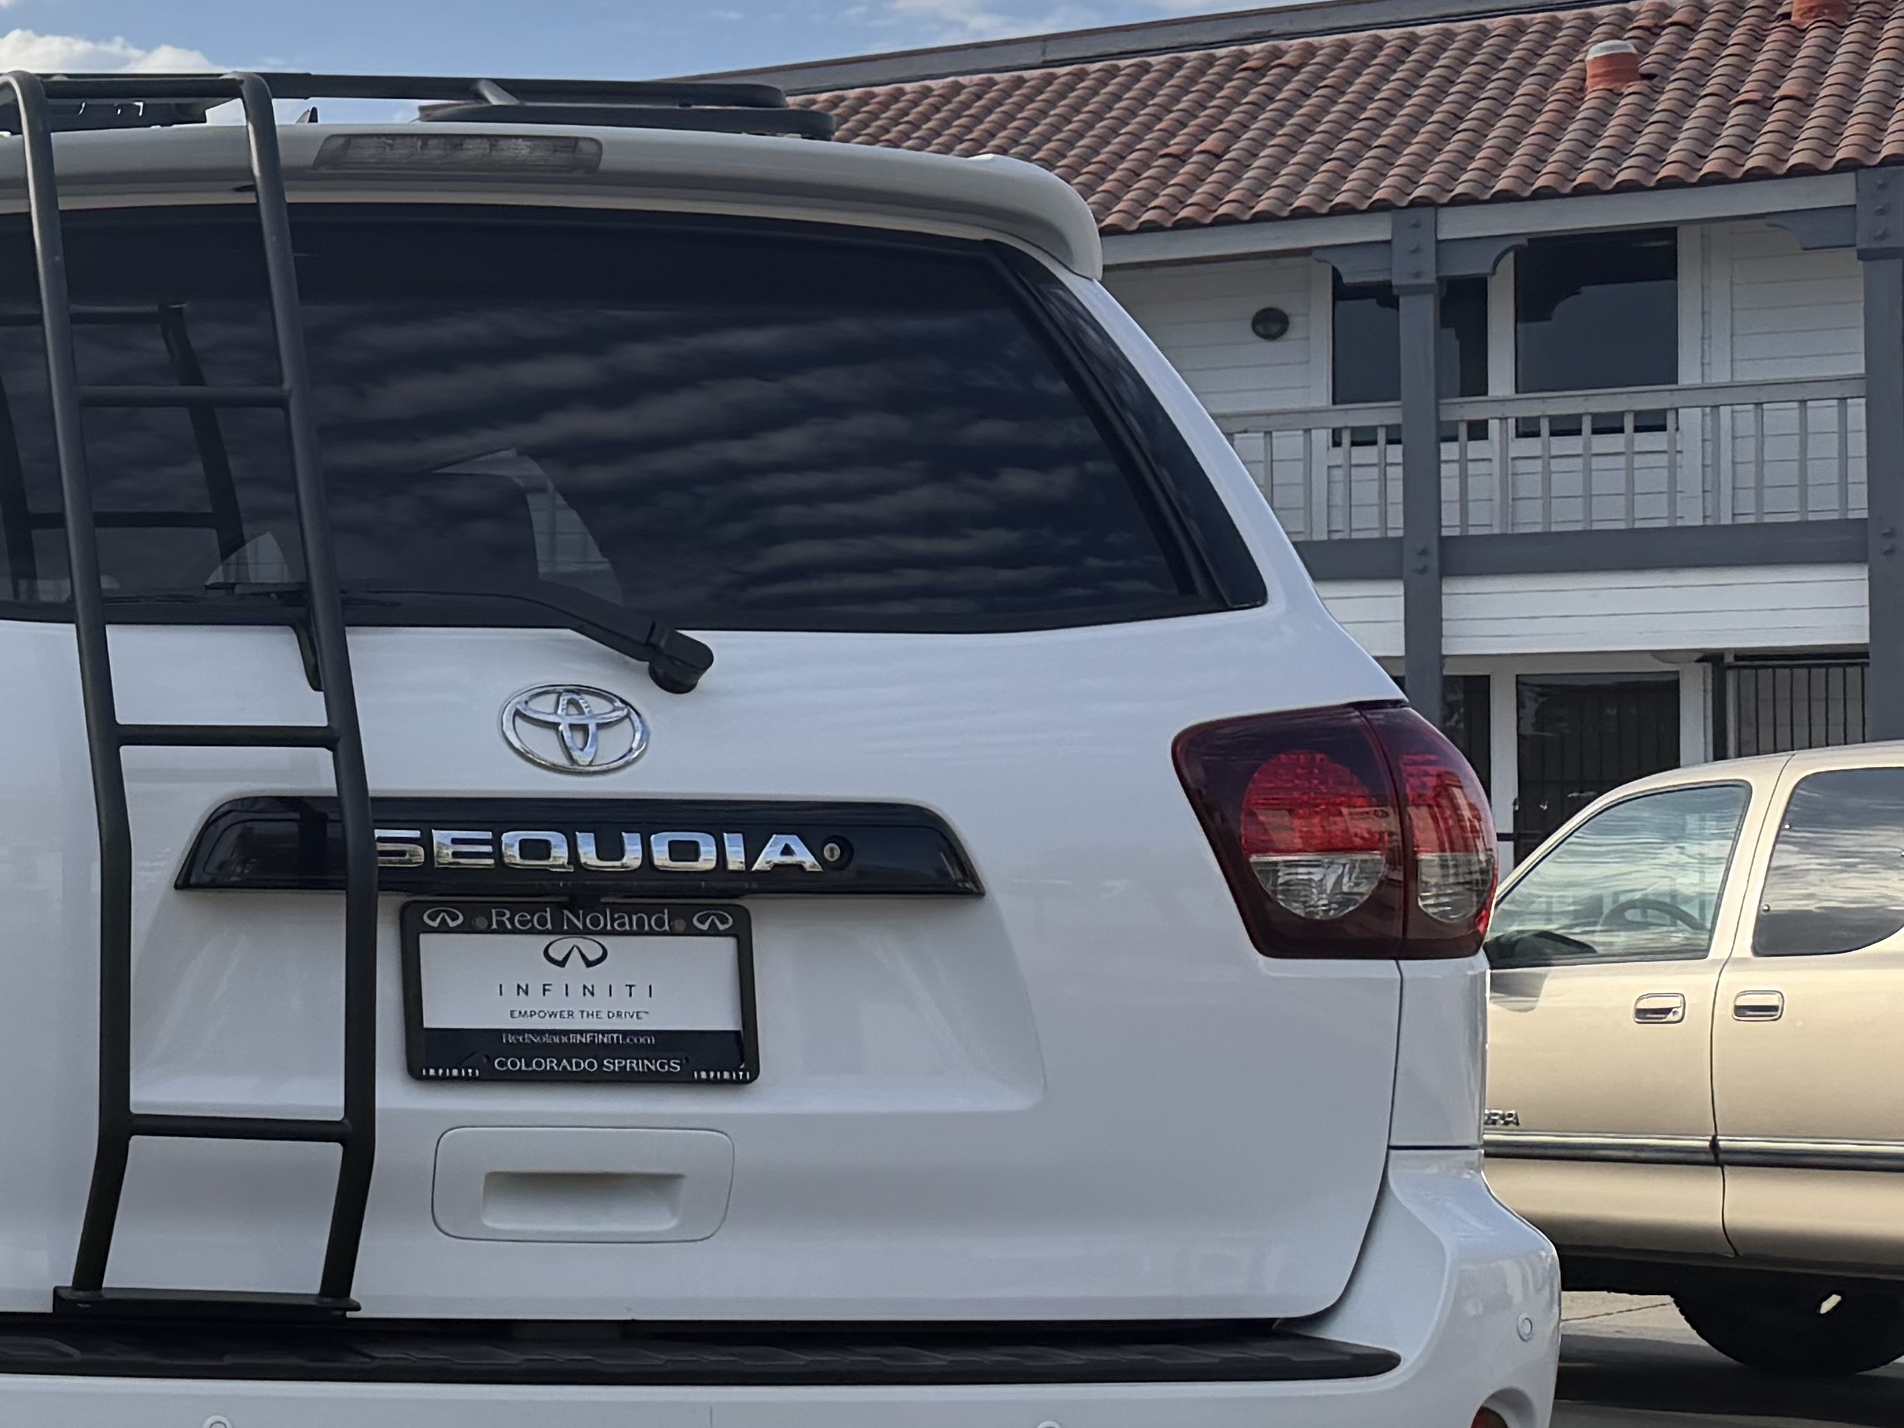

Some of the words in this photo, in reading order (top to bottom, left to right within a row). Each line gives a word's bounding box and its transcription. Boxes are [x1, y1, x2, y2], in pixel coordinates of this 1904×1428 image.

[375, 829, 825, 872] SEQUOIA
[491, 907, 553, 930] Red
[562, 908, 670, 932] Noland
[498, 983, 653, 998] INFINITI
[509, 1009, 575, 1019] EMPOWER
[579, 1010, 602, 1019] THE
[494, 1057, 598, 1072] COLORADO
[603, 1059, 682, 1073] SPRINGS
